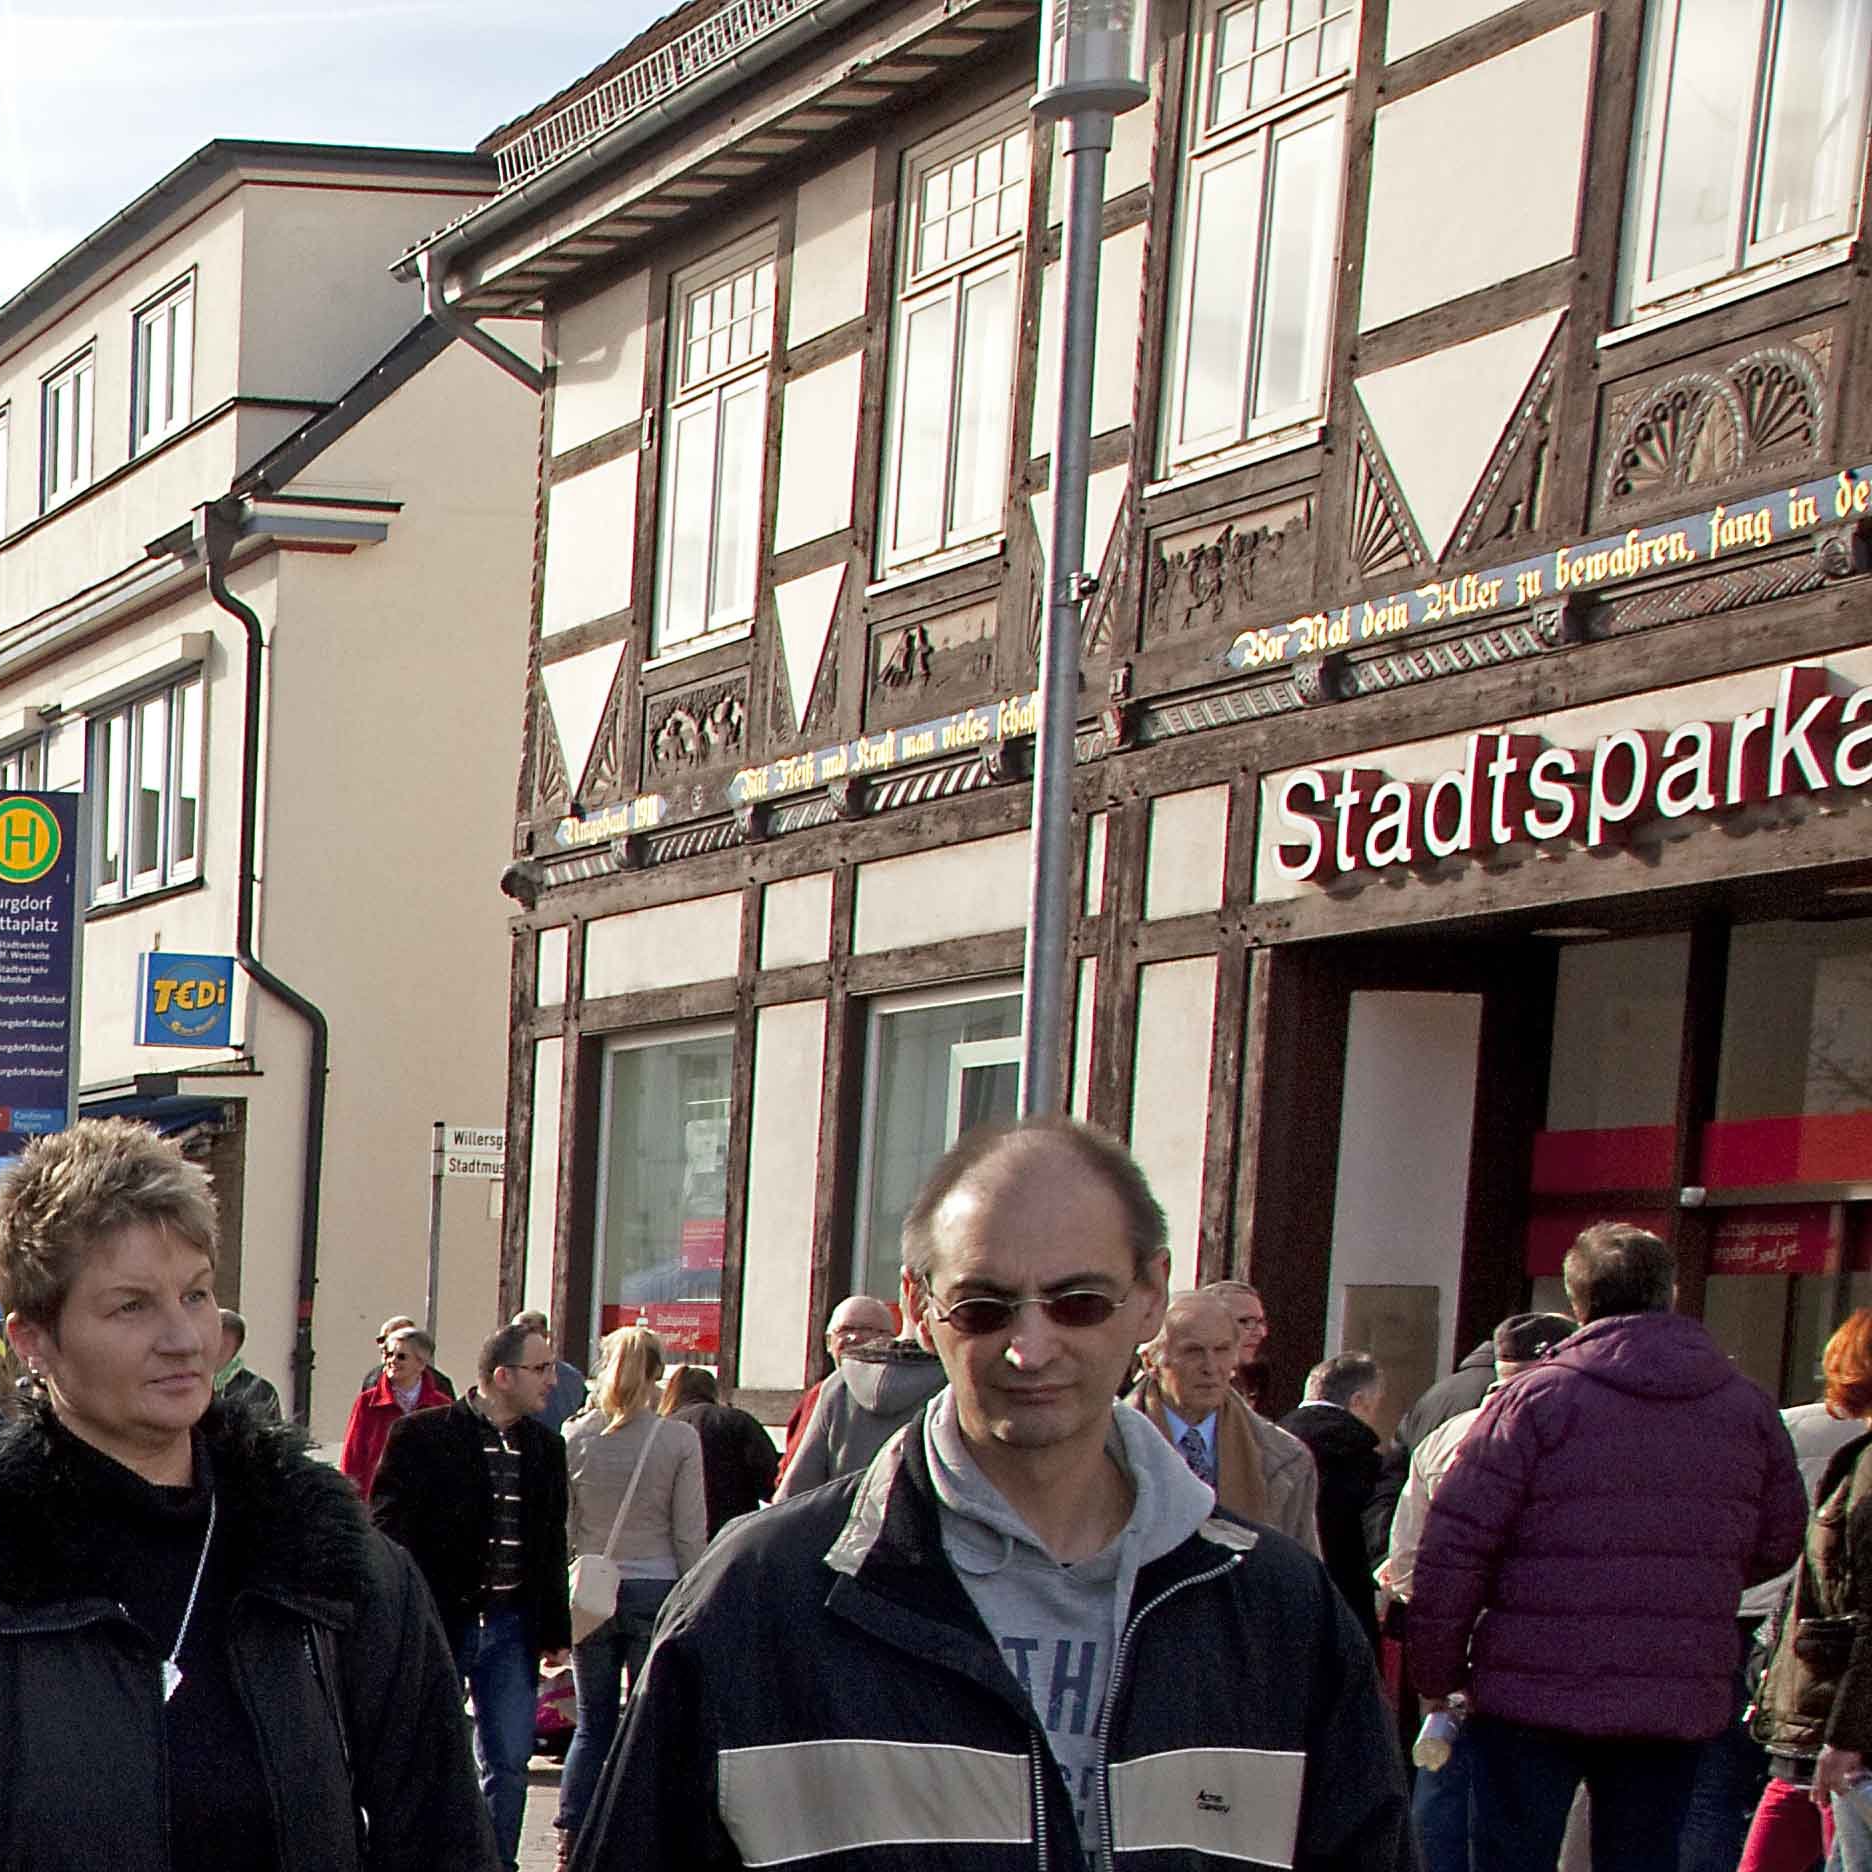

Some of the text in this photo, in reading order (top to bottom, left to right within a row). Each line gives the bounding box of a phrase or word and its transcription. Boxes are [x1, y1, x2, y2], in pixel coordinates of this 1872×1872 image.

[1233, 628, 1290, 666] Vor
[1361, 597, 1409, 639] dein
[1516, 568, 1543, 606] zu
[1555, 528, 1697, 583] bewahren,
[1708, 507, 1774, 559] fang
[1788, 487, 1821, 531] in
[1835, 469, 1872, 519] de
[902, 731, 935, 759] man
[1271, 665, 1872, 883] Stadtsparka
[0, 941, 50, 950] Stadtverkehr
[454, 1131, 504, 1151] Willersg
[449, 1157, 505, 1174] Stadtmus
